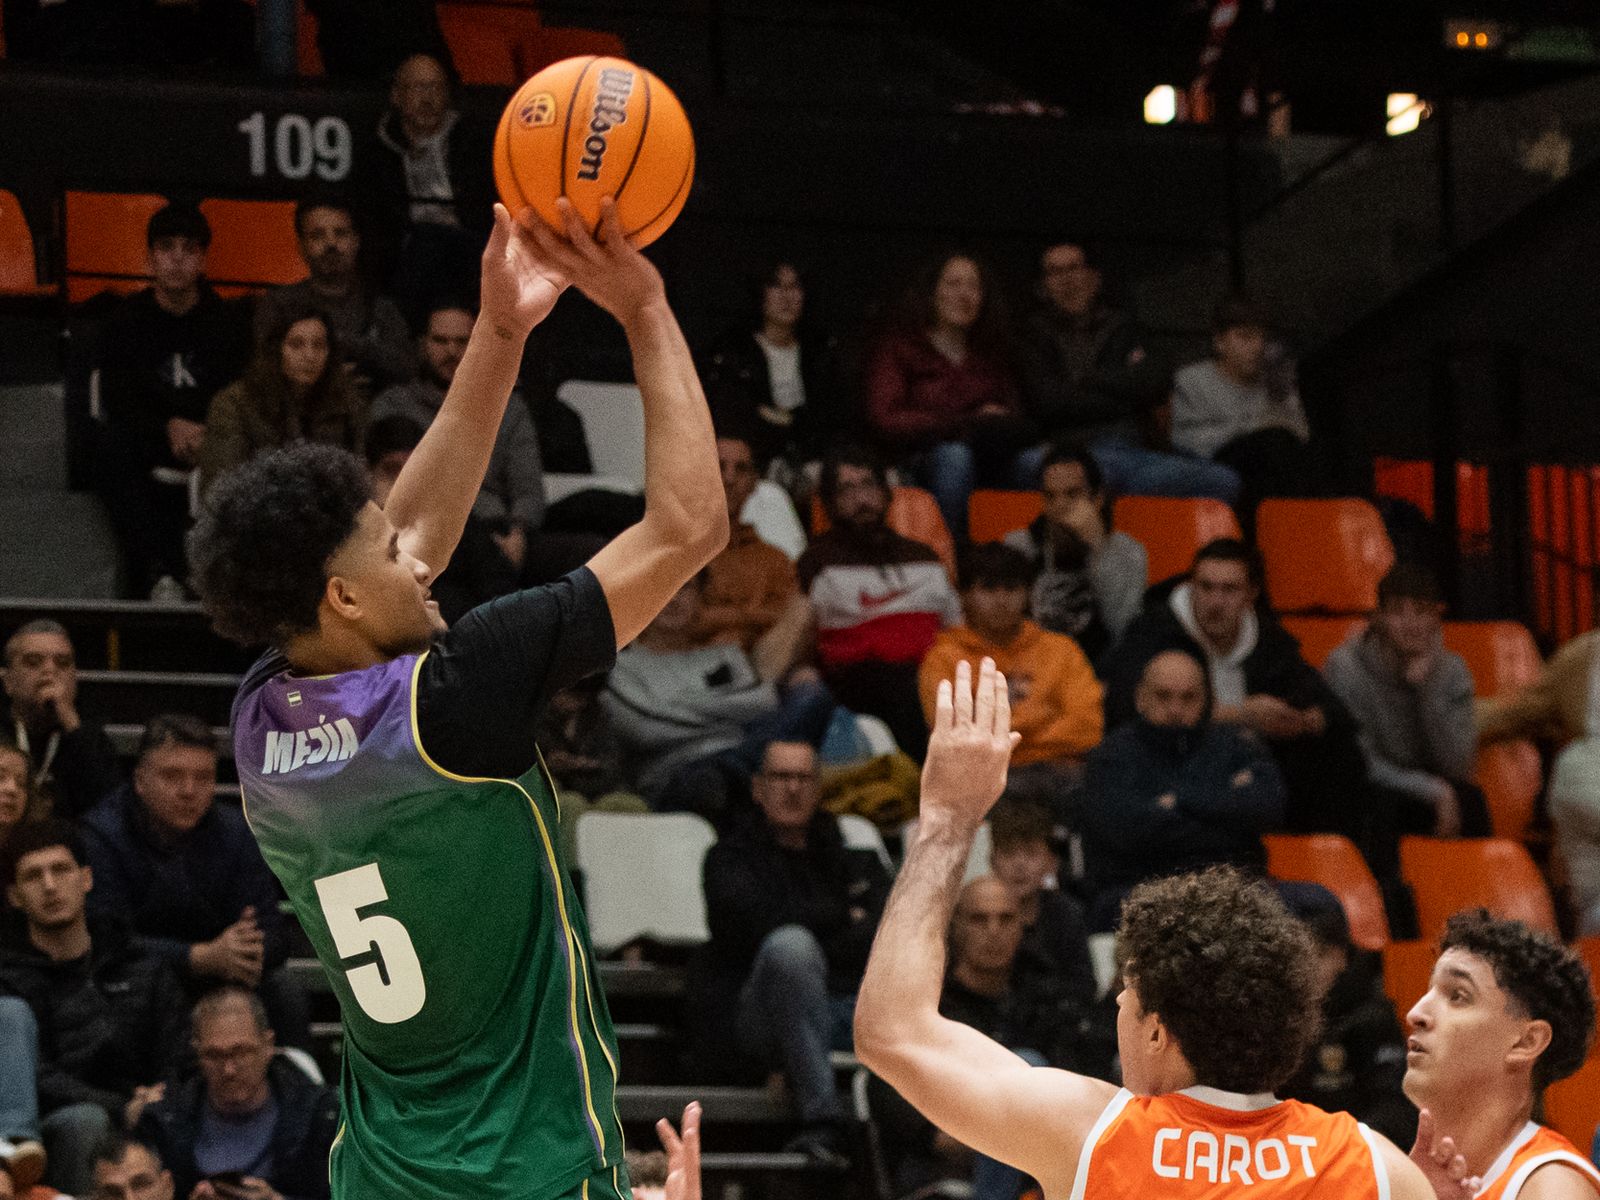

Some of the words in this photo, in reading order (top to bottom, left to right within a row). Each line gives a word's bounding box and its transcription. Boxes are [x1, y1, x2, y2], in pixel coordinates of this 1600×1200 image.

[239, 111, 352, 181] 109
[577, 68, 634, 181] Wilson
[313, 862, 427, 1024] 5
[1152, 1127, 1318, 1185] CAROT
